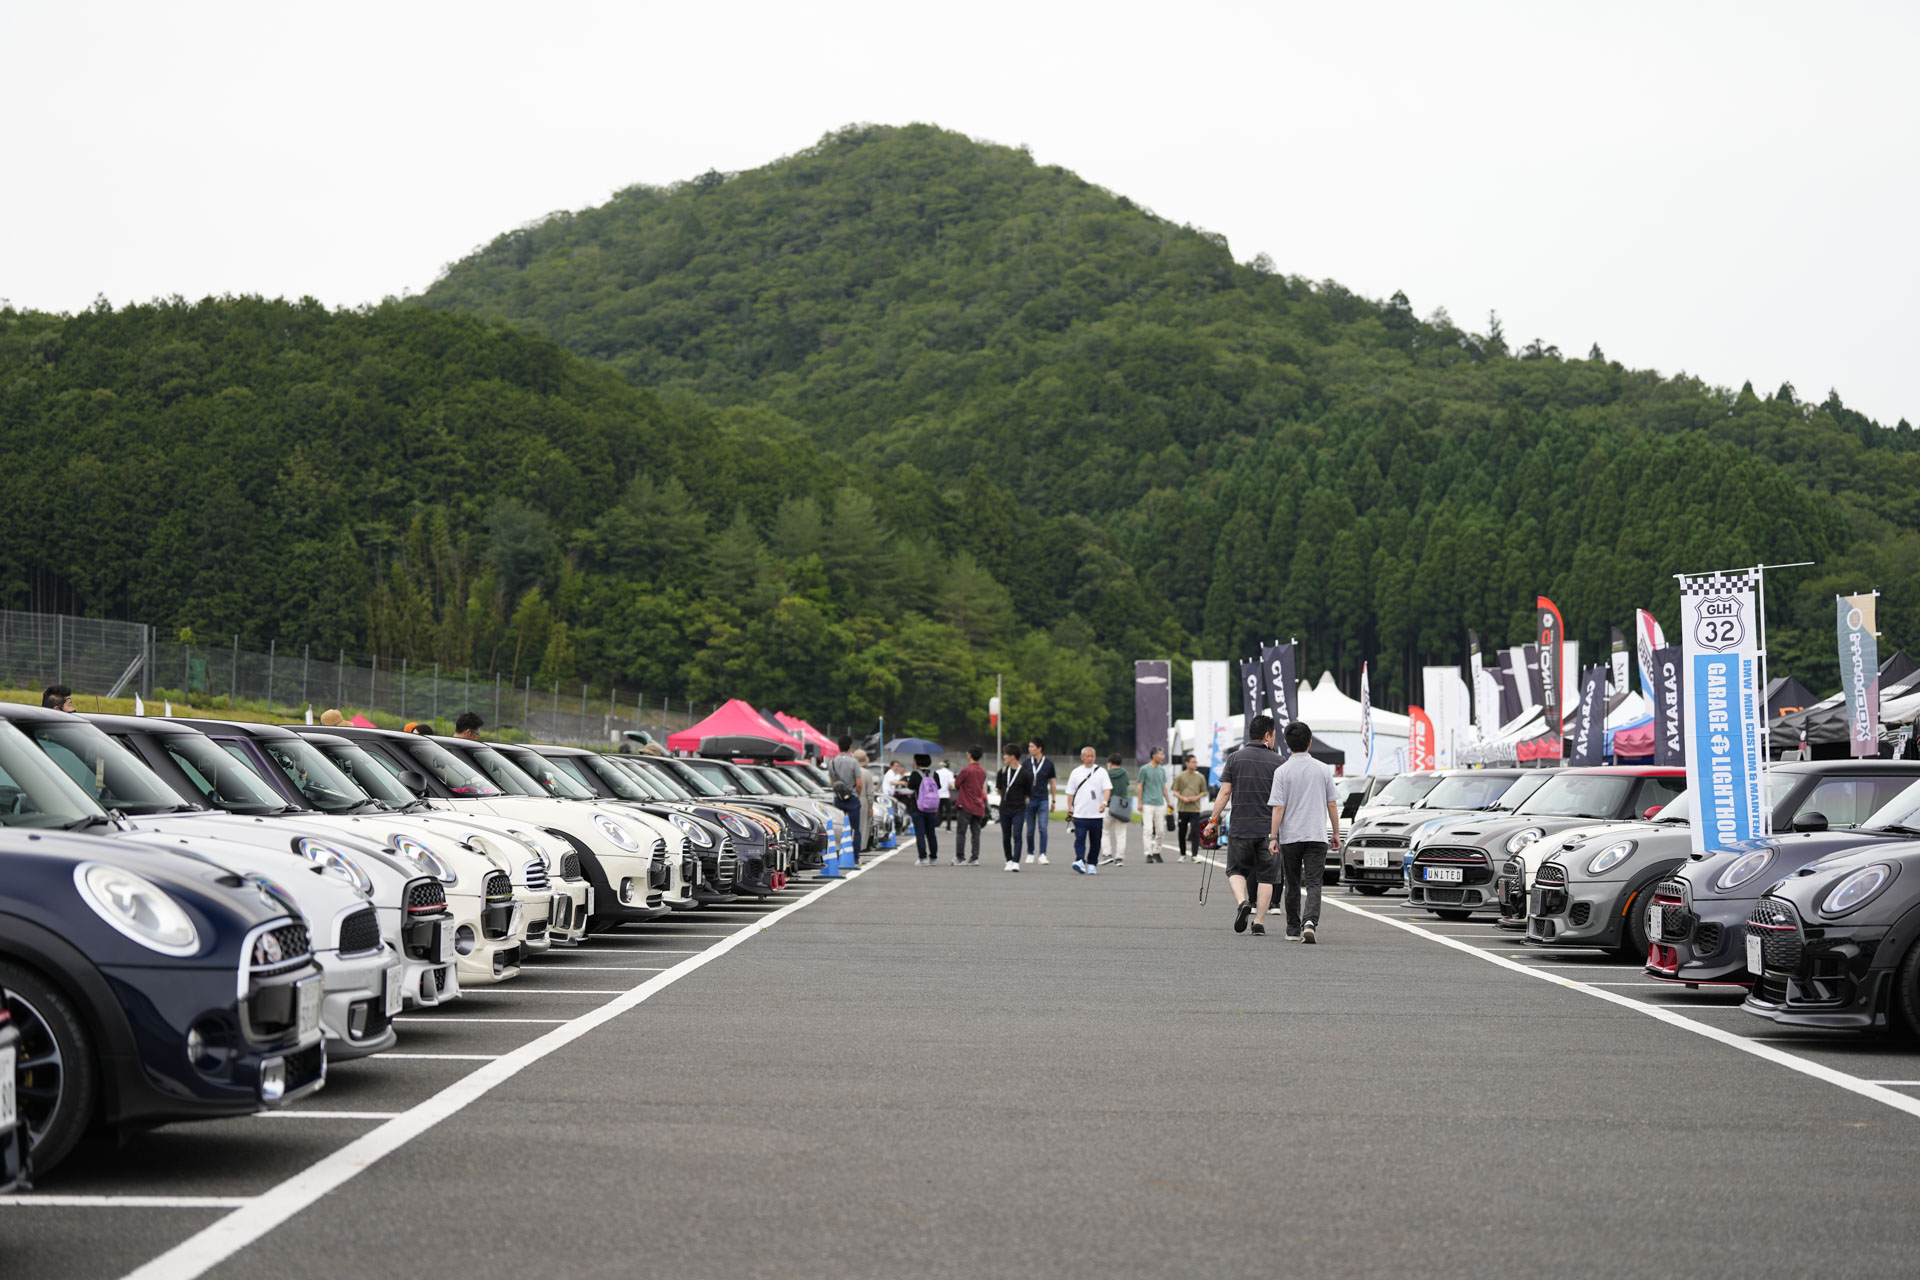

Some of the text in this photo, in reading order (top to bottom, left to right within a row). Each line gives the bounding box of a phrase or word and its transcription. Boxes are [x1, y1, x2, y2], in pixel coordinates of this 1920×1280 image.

[1706, 603, 1732, 615] GLH
[1705, 620, 1735, 643] 32
[1742, 659, 1753, 690] BMW
[1707, 662, 1729, 733] GARAGE
[1744, 693, 1754, 720] MINI
[1745, 722, 1758, 772] CUSTOM
[1749, 773, 1758, 781] &
[1427, 868, 1462, 881] UNITED
